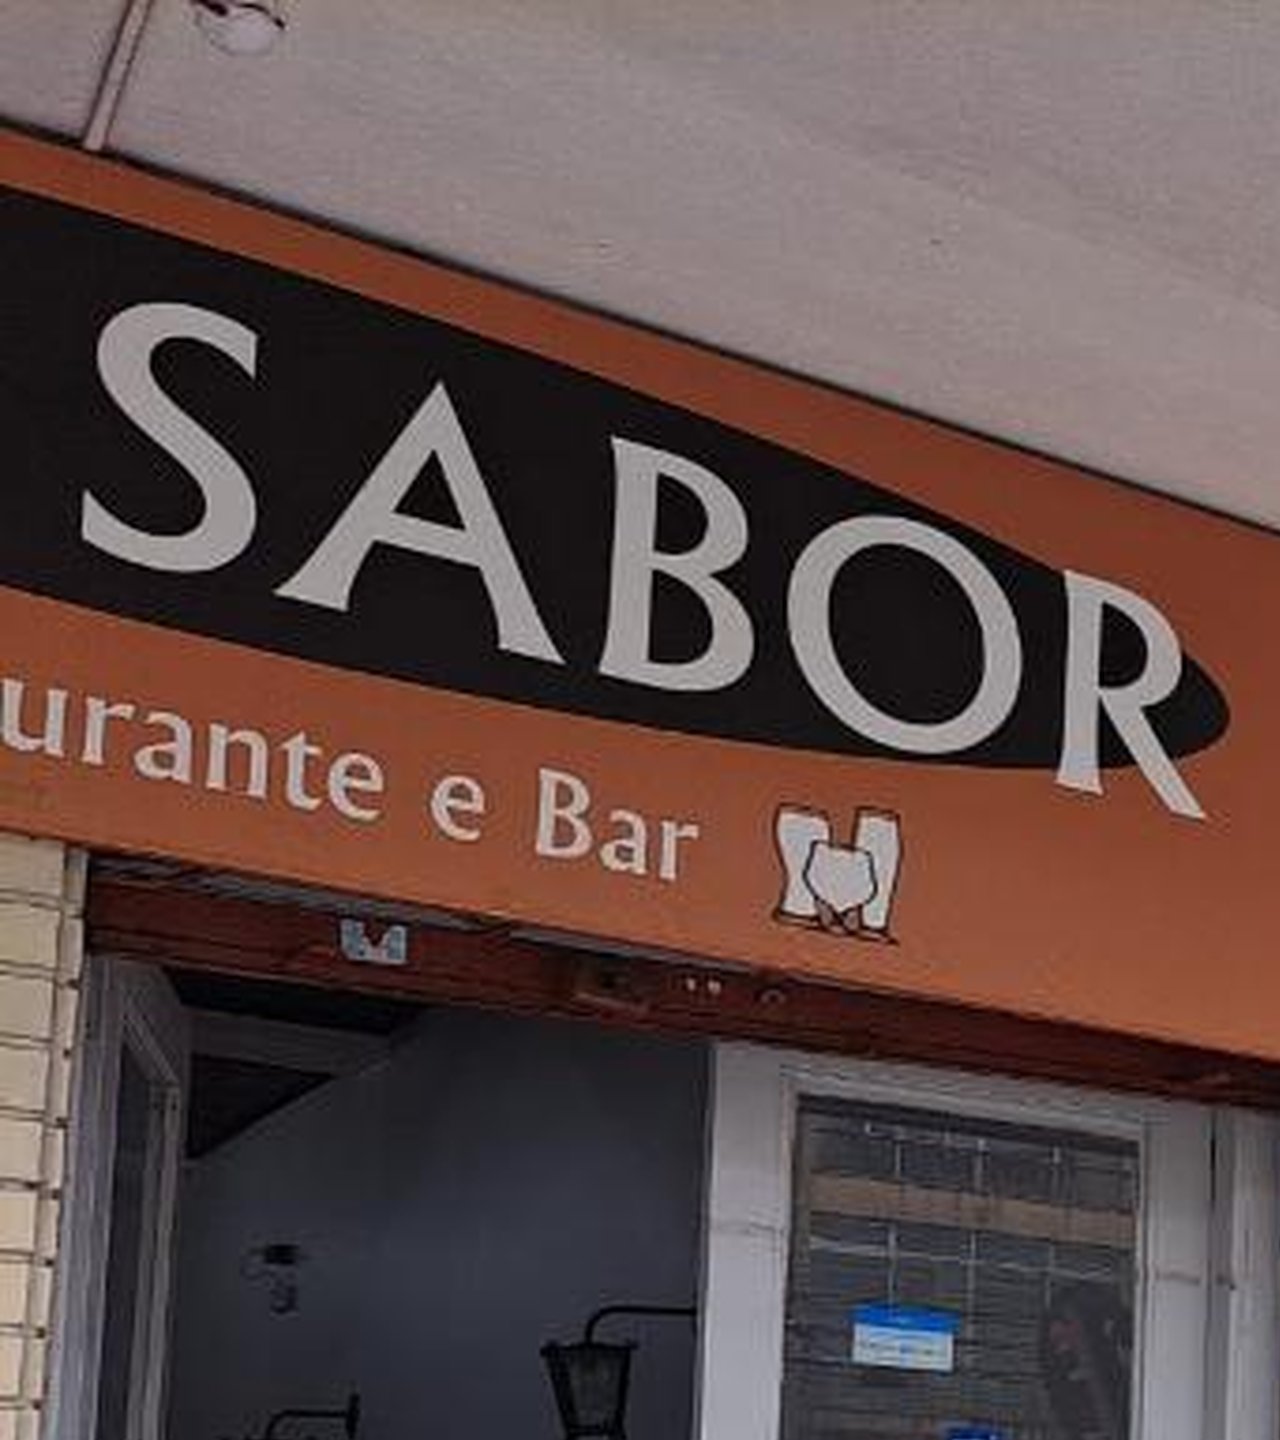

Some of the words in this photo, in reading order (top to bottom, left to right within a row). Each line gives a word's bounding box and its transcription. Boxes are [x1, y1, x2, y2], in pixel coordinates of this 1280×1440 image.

[82, 303, 1206, 820] SABOR
[430, 769, 485, 843] e
[535, 767, 698, 882] Bar
